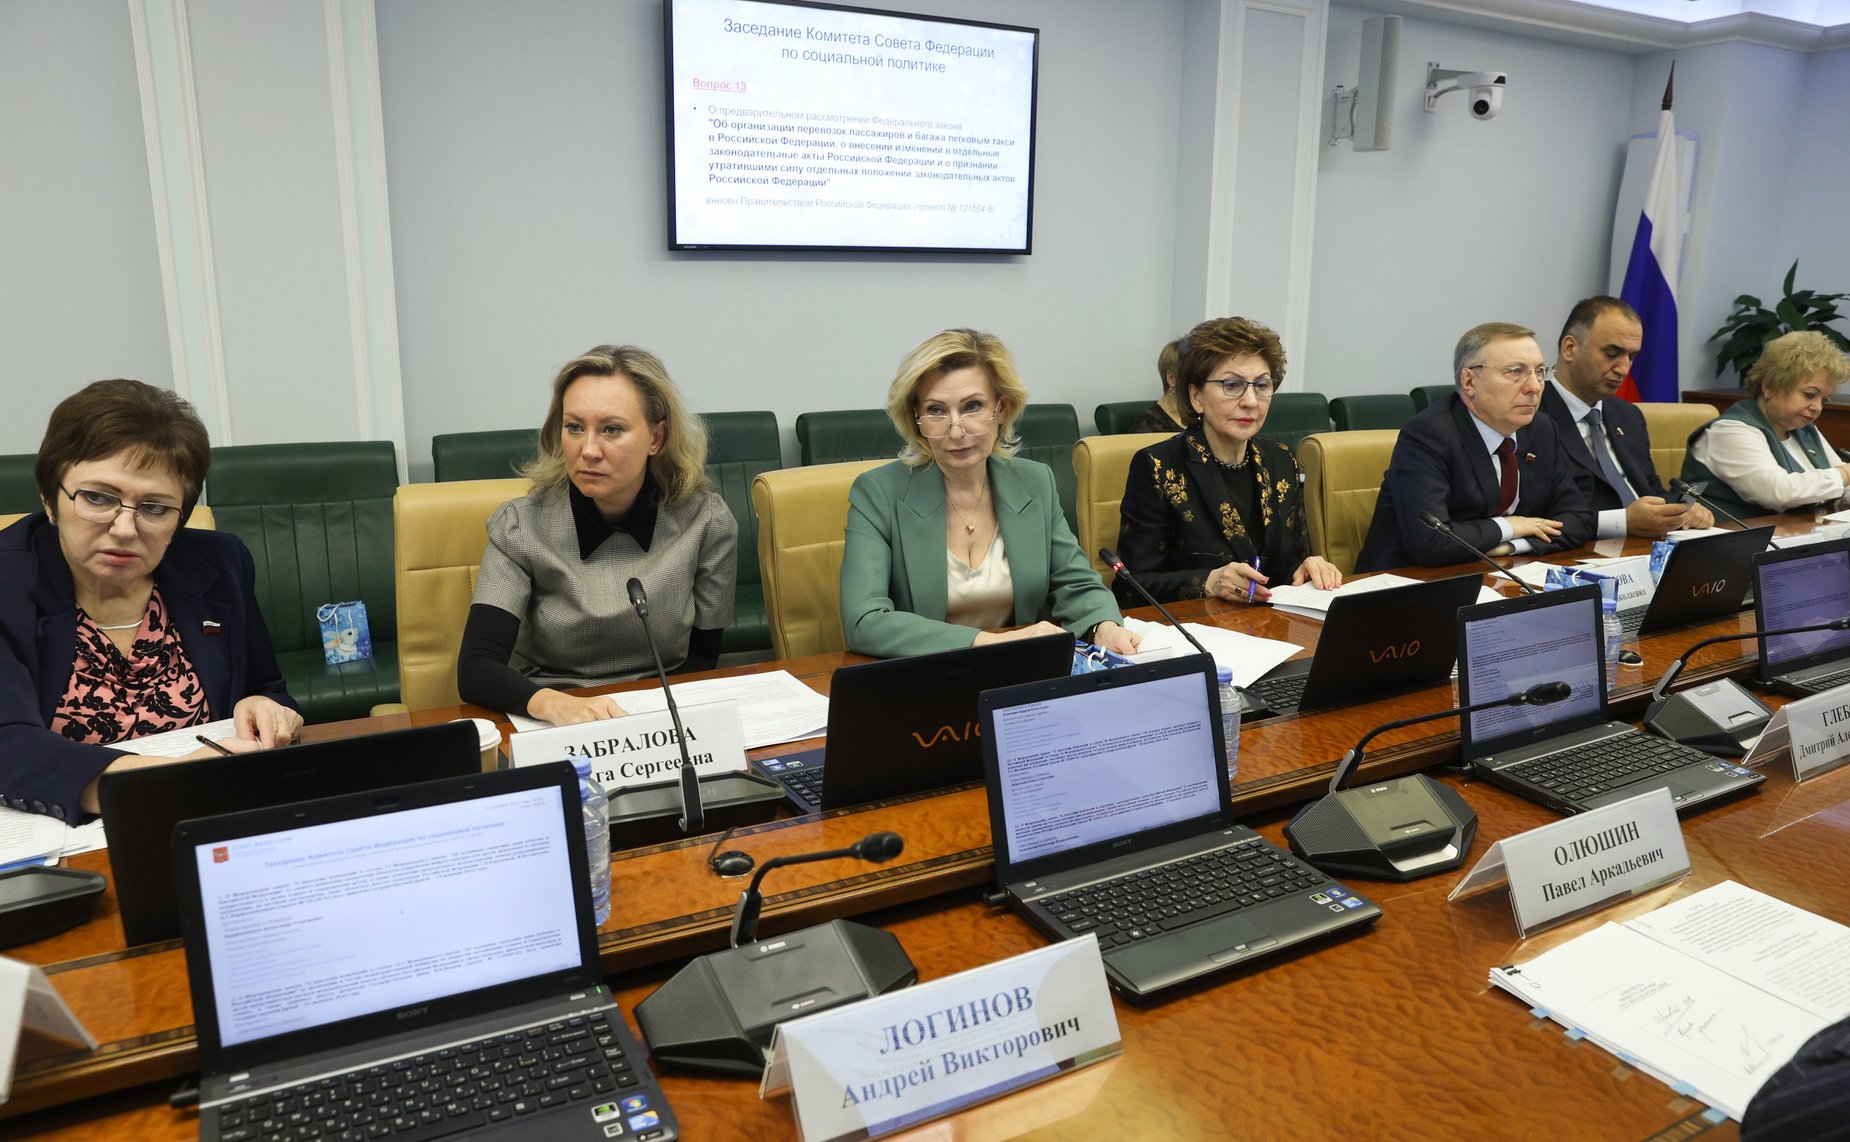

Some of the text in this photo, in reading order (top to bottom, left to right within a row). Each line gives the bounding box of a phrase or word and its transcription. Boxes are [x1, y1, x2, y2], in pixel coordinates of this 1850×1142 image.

[724, 18, 994, 58] Заседание Комитета Совета Федерации
[782, 48, 946, 72] по социальной политике
[692, 78, 746, 91] Вопрос 13
[708, 105, 962, 130] О предварительном рассмотрении Федерального закона
[708, 118, 728, 128] "Об
[730, 120, 794, 132] организации
[798, 126, 847, 136] перевозок
[850, 128, 904, 140] пассажиров
[916, 132, 946, 142] багажа
[948, 136, 990, 144] легковым
[992, 138, 1015, 146] такси
[708, 134, 714, 142] в
[718, 133, 778, 144] Российской
[780, 136, 838, 148] Федерации,
[840, 140, 846, 148] о
[850, 142, 892, 152] внесении
[953, 148, 1000, 158] отдельные
[708, 148, 798, 159] законодательные
[802, 152, 824, 160] акты
[828, 152, 882, 163] Российской
[884, 156, 934, 166] Федерации
[952, 162, 998, 170] признании
[708, 161, 1016, 183] утратившими силу отдельных положений законодательных актов
[709, 174, 831, 188] Российской Федерации"
[706, 196, 738, 205] внесен
[740, 196, 814, 208] Правительством
[816, 198, 864, 208] Российской
[866, 201, 910, 211] Федерации
[1692, 579, 1726, 597] VAIO
[1368, 639, 1421, 664] VAIO
[1822, 704, 1850, 727] ГЛЕБ
[564, 726, 697, 759] ЗАБРАЛОВА
[1799, 734, 1836, 760] Дмитрий
[620, 751, 714, 780] Сергеена
[1112, 839, 1132, 848] SONY
[1554, 820, 1641, 866] ОЛЮШИН
[1542, 848, 1664, 902] Павел Аркадьевич
[396, 1006, 429, 1020] SONY
[880, 986, 1034, 1054] ЛОГИНОВ
[841, 1016, 1081, 1109] Андрей Викторович
